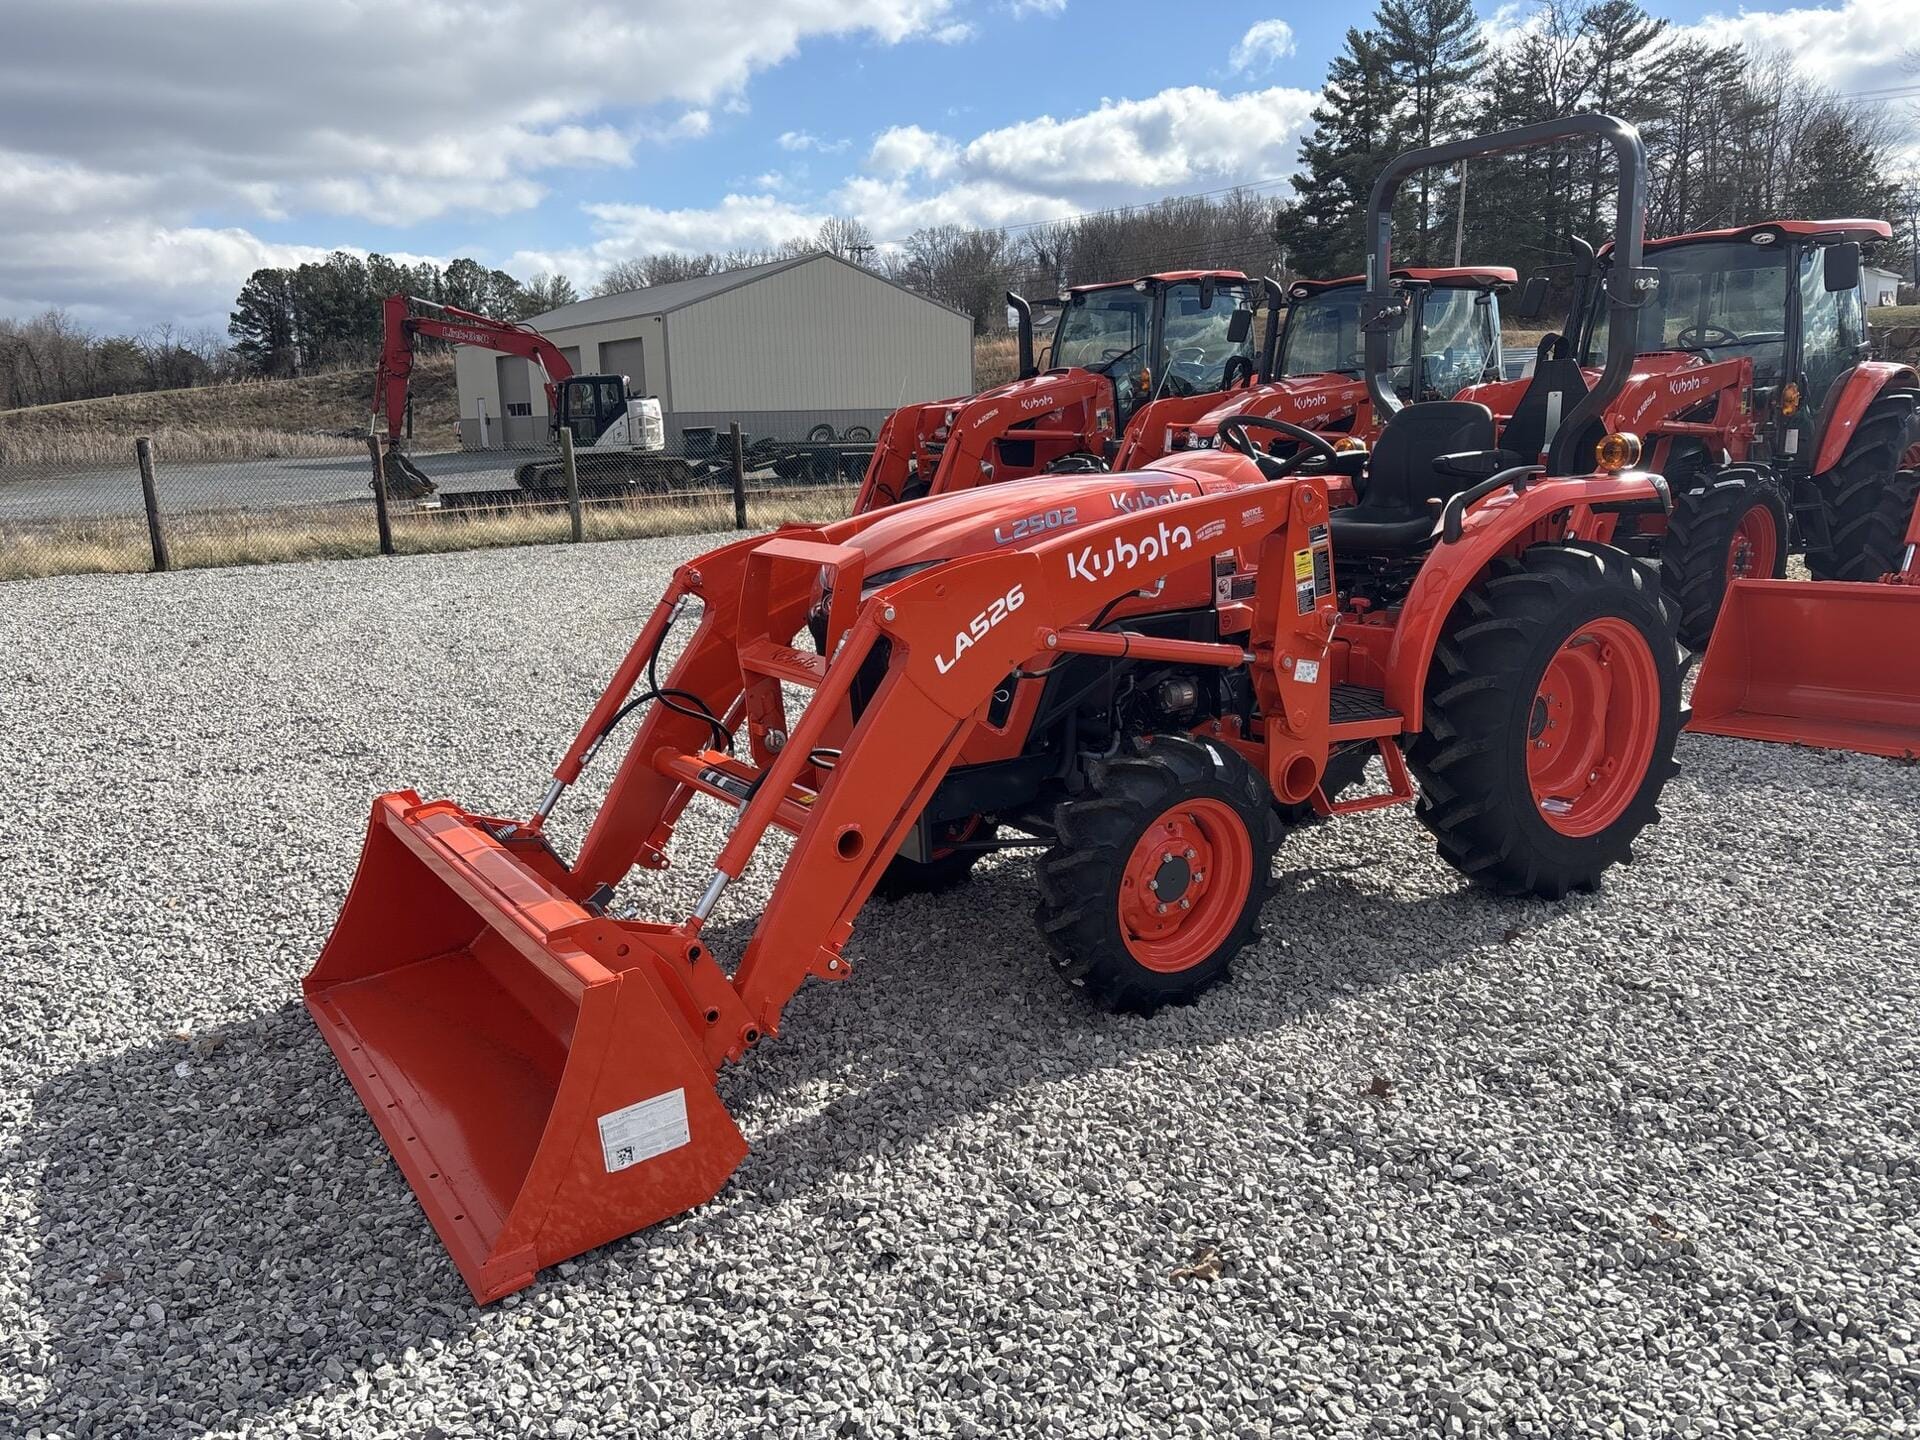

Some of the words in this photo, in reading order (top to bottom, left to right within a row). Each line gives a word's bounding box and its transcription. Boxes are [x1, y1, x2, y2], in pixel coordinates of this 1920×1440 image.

[1668, 375, 1700, 395] Kubota
[1021, 395, 1053, 409] Kubota
[1294, 393, 1327, 409] Kubota
[1109, 488, 1192, 512] Kubota
[994, 506, 1078, 544] L2502
[1067, 522, 1192, 582] Kubota
[934, 583, 1025, 675] LA526
